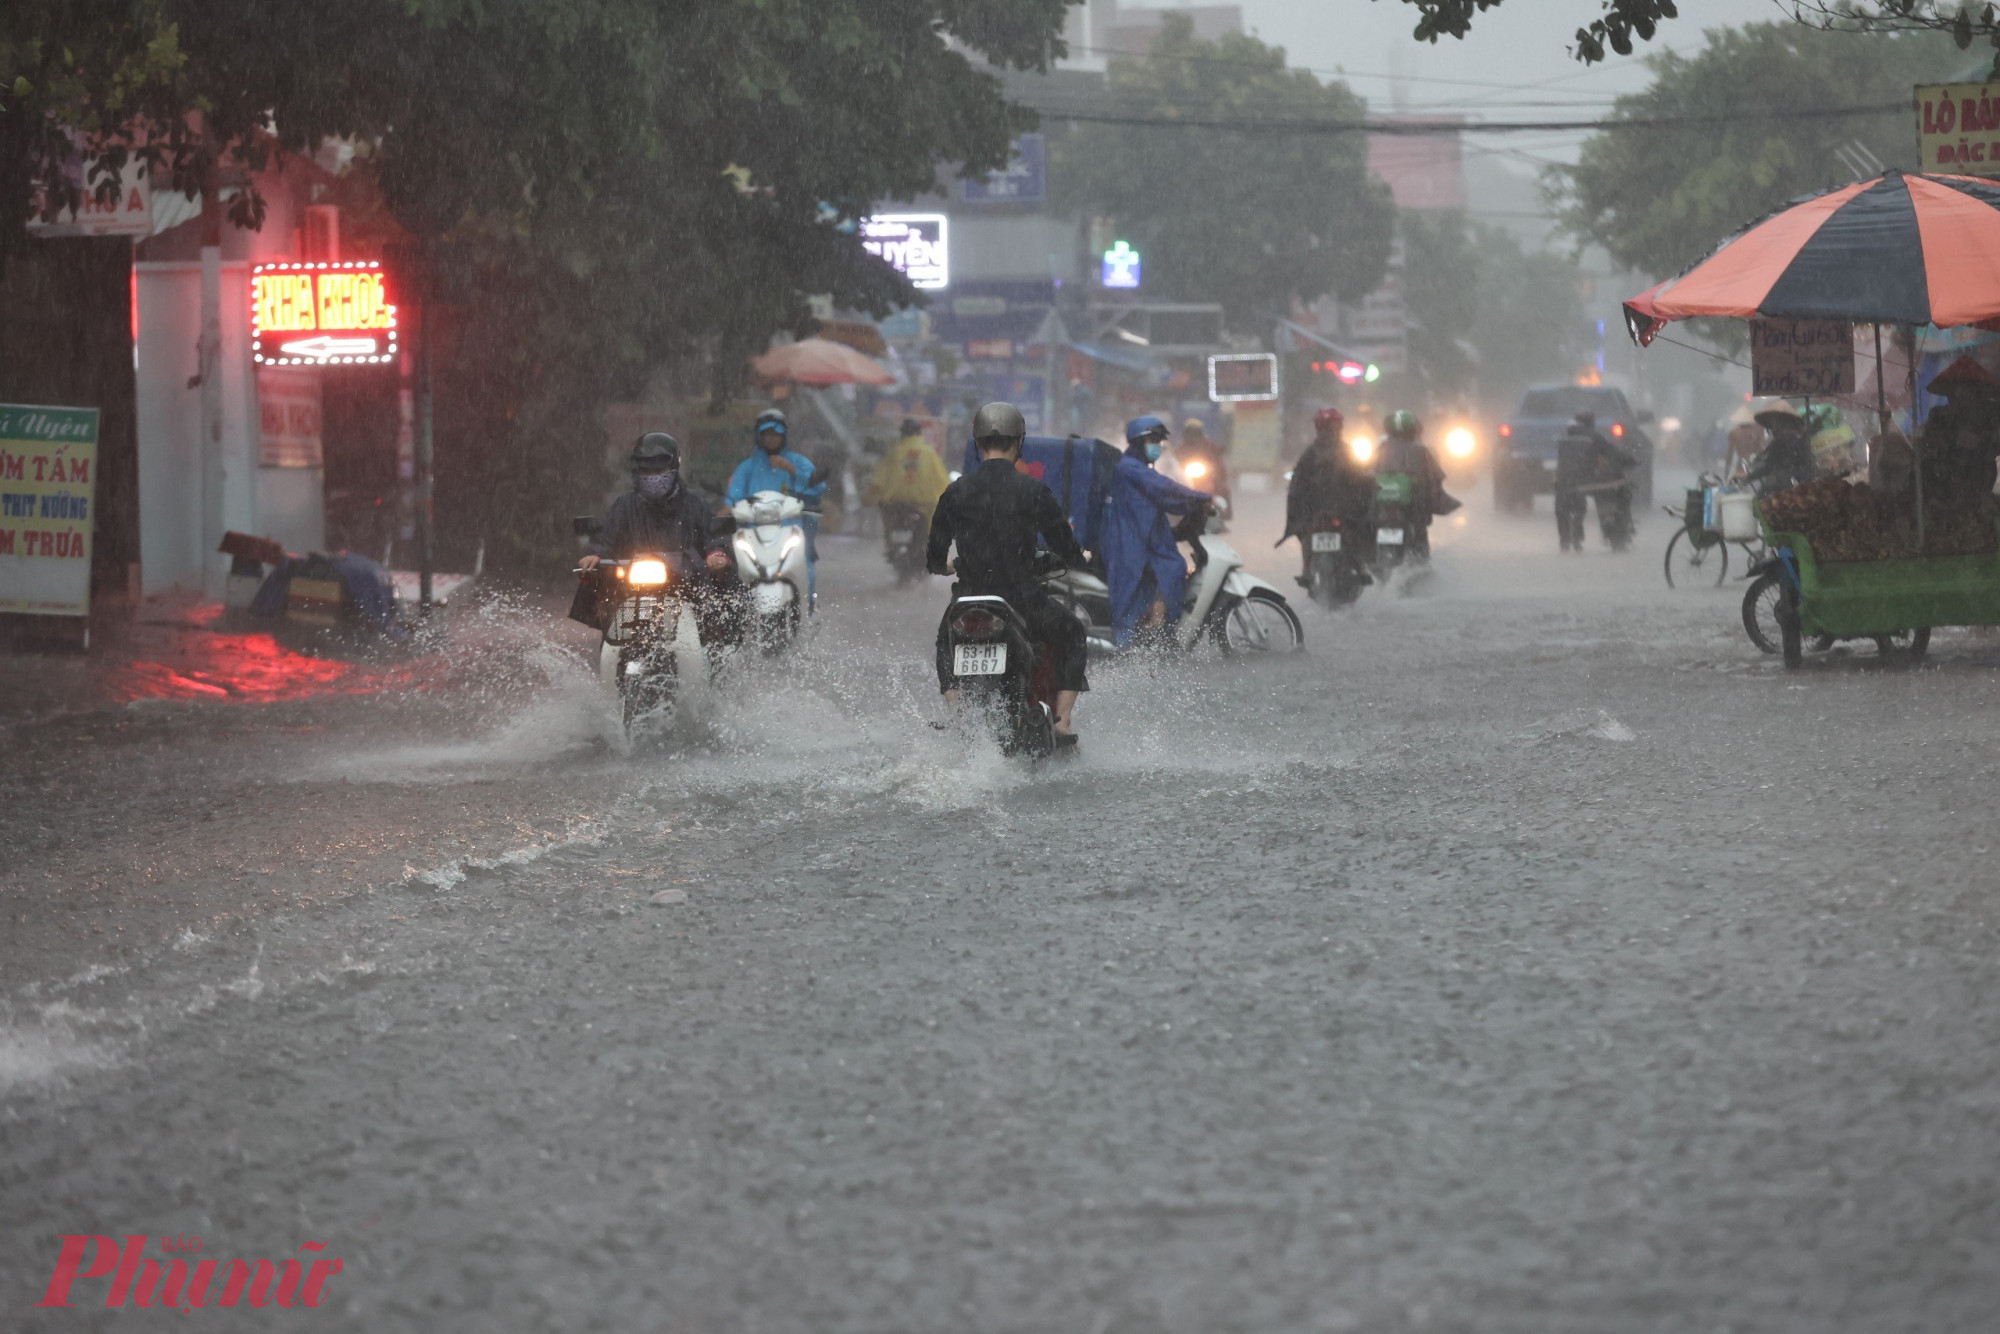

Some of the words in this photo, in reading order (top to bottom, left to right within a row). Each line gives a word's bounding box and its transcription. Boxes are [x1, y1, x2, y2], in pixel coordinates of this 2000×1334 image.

[1923, 88, 1956, 135] LÒ
[18, 412, 90, 440] Uyên
[32, 444, 90, 484] TẤM
[24, 525, 85, 558] TRƯA
[961, 659, 999, 673] 6667
